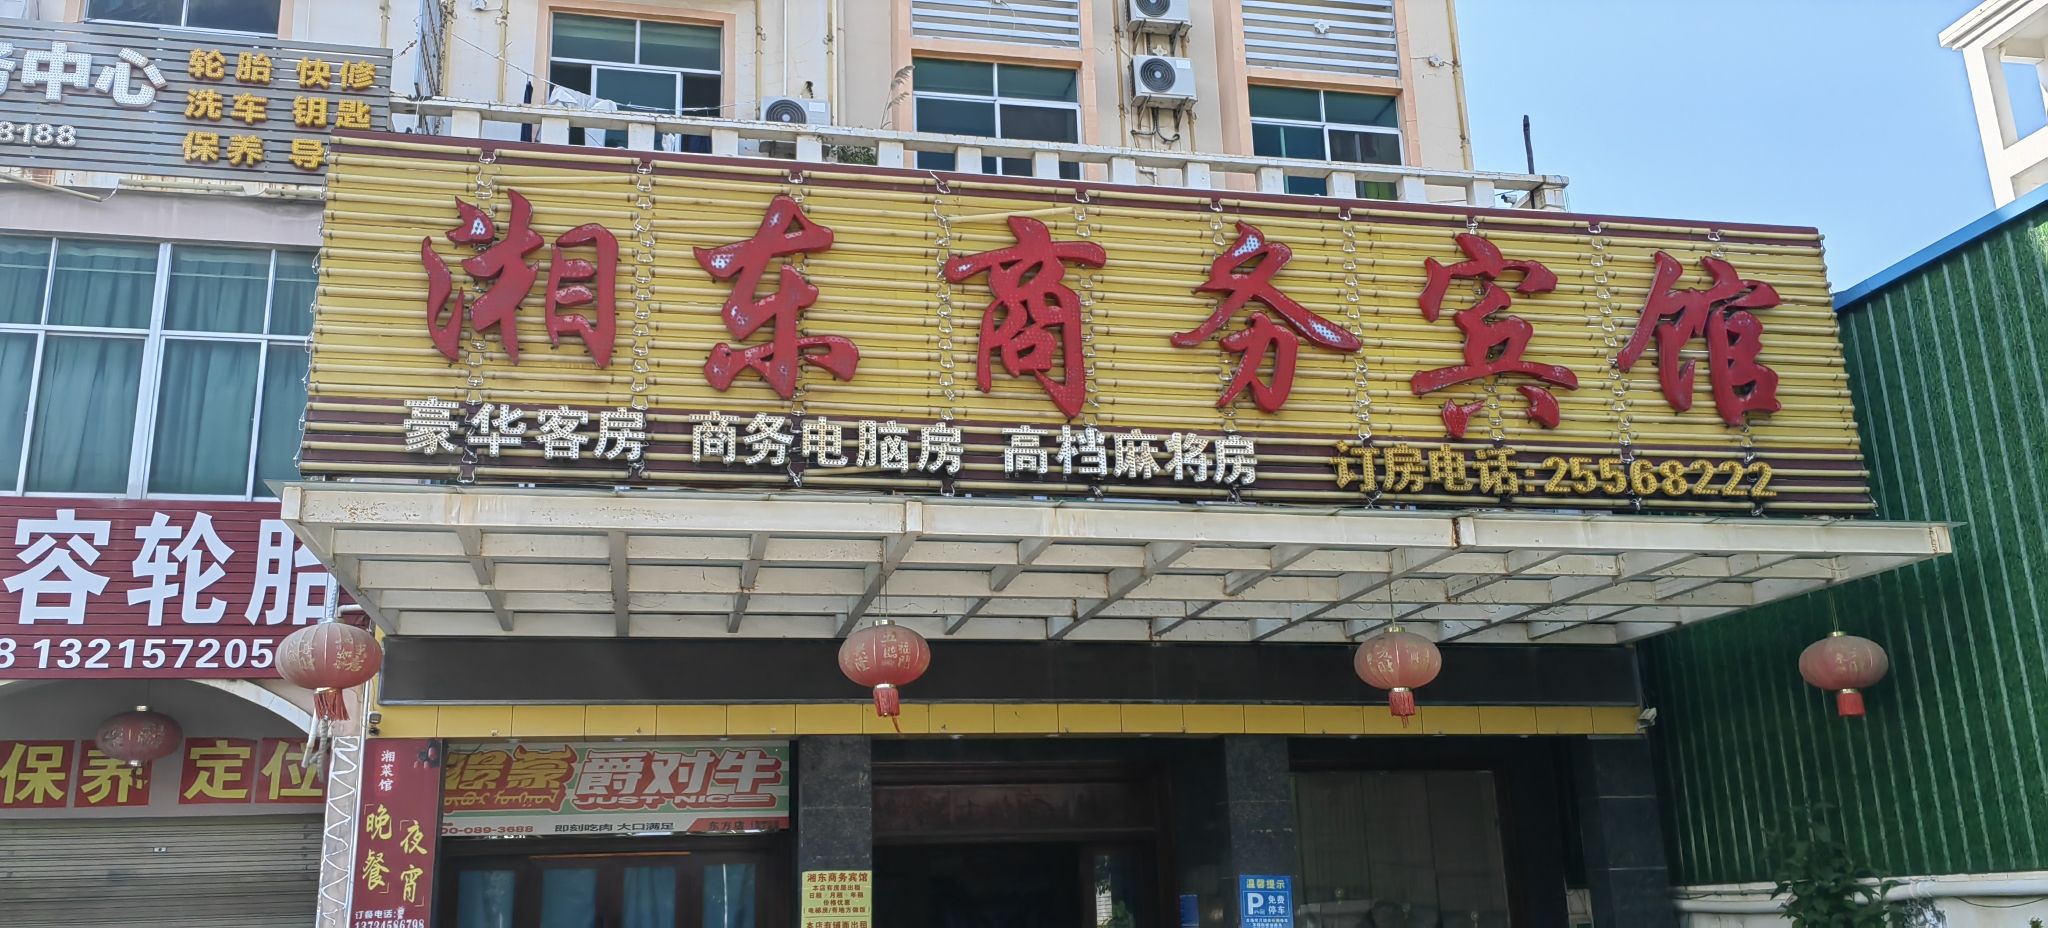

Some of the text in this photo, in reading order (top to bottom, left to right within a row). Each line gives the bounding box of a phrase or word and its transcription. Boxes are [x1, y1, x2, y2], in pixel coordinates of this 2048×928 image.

[0, 41, 168, 108] 中心
[188, 48, 376, 90] 轮胎 快修
[184, 88, 371, 130] 洗车 钥匙
[0, 121, 77, 147] 8188
[183, 130, 325, 171] 保养 导
[421, 188, 1779, 440] 湘东商务宾馆
[403, 396, 646, 461] 豪华客房
[689, 410, 964, 476] 商务电脑房
[1002, 424, 1258, 483] 高档麻将房
[2, 508, 337, 626] 容轮胎
[0, 740, 324, 804] 保养 定位
[378, 749, 396, 792] 湘菜馆
[575, 750, 778, 794] 爵对牛
[573, 794, 661, 805] JUST
[673, 793, 771, 804] NICE
[362, 803, 393, 891] 晚餐
[554, 822, 675, 833] 即刻吃肉 大口满足
[400, 819, 428, 903] 夜宵
[807, 872, 868, 882] 湘东商务宾馆
[1246, 878, 1285, 889] 温馨提示
[1247, 892, 1264, 915] P
[1268, 895, 1285, 904] 免费
[1268, 905, 1285, 915] 停车
